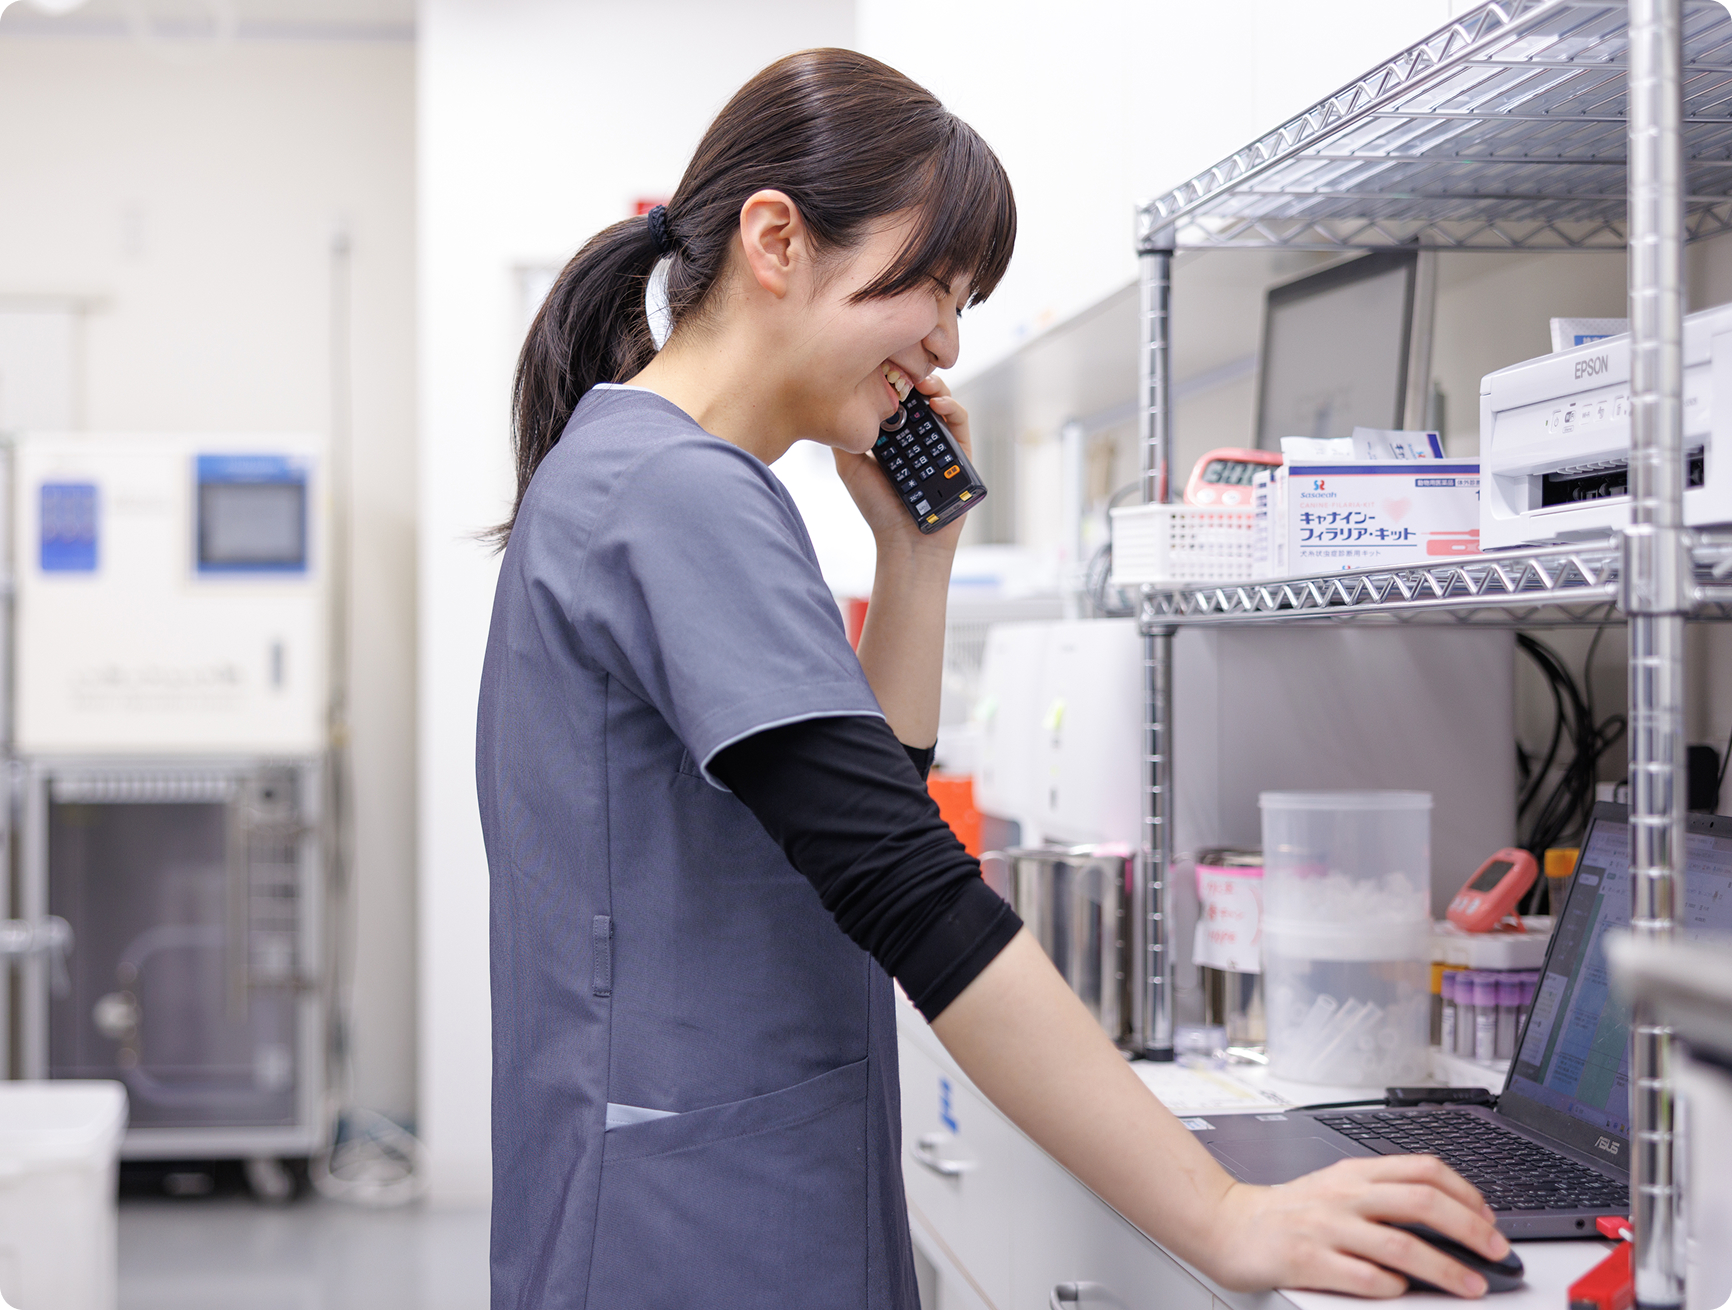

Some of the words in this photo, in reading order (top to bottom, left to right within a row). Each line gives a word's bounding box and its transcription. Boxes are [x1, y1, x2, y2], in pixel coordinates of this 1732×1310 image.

[1575, 355, 1608, 380] EPSON
[906, 434, 914, 442] 2
[923, 421, 932, 430] 3
[896, 457, 903, 465] 4
[912, 445, 920, 453] 5
[930, 433, 938, 441] 6
[901, 468, 908, 476] 7
[919, 455, 927, 464] 8
[937, 443, 945, 451] 9
[926, 466, 935, 475] 0
[1300, 512, 1376, 525] キャナインー
[1300, 528, 1416, 541] フィラリア・キット
[1594, 1136, 1620, 1155] ASUS
